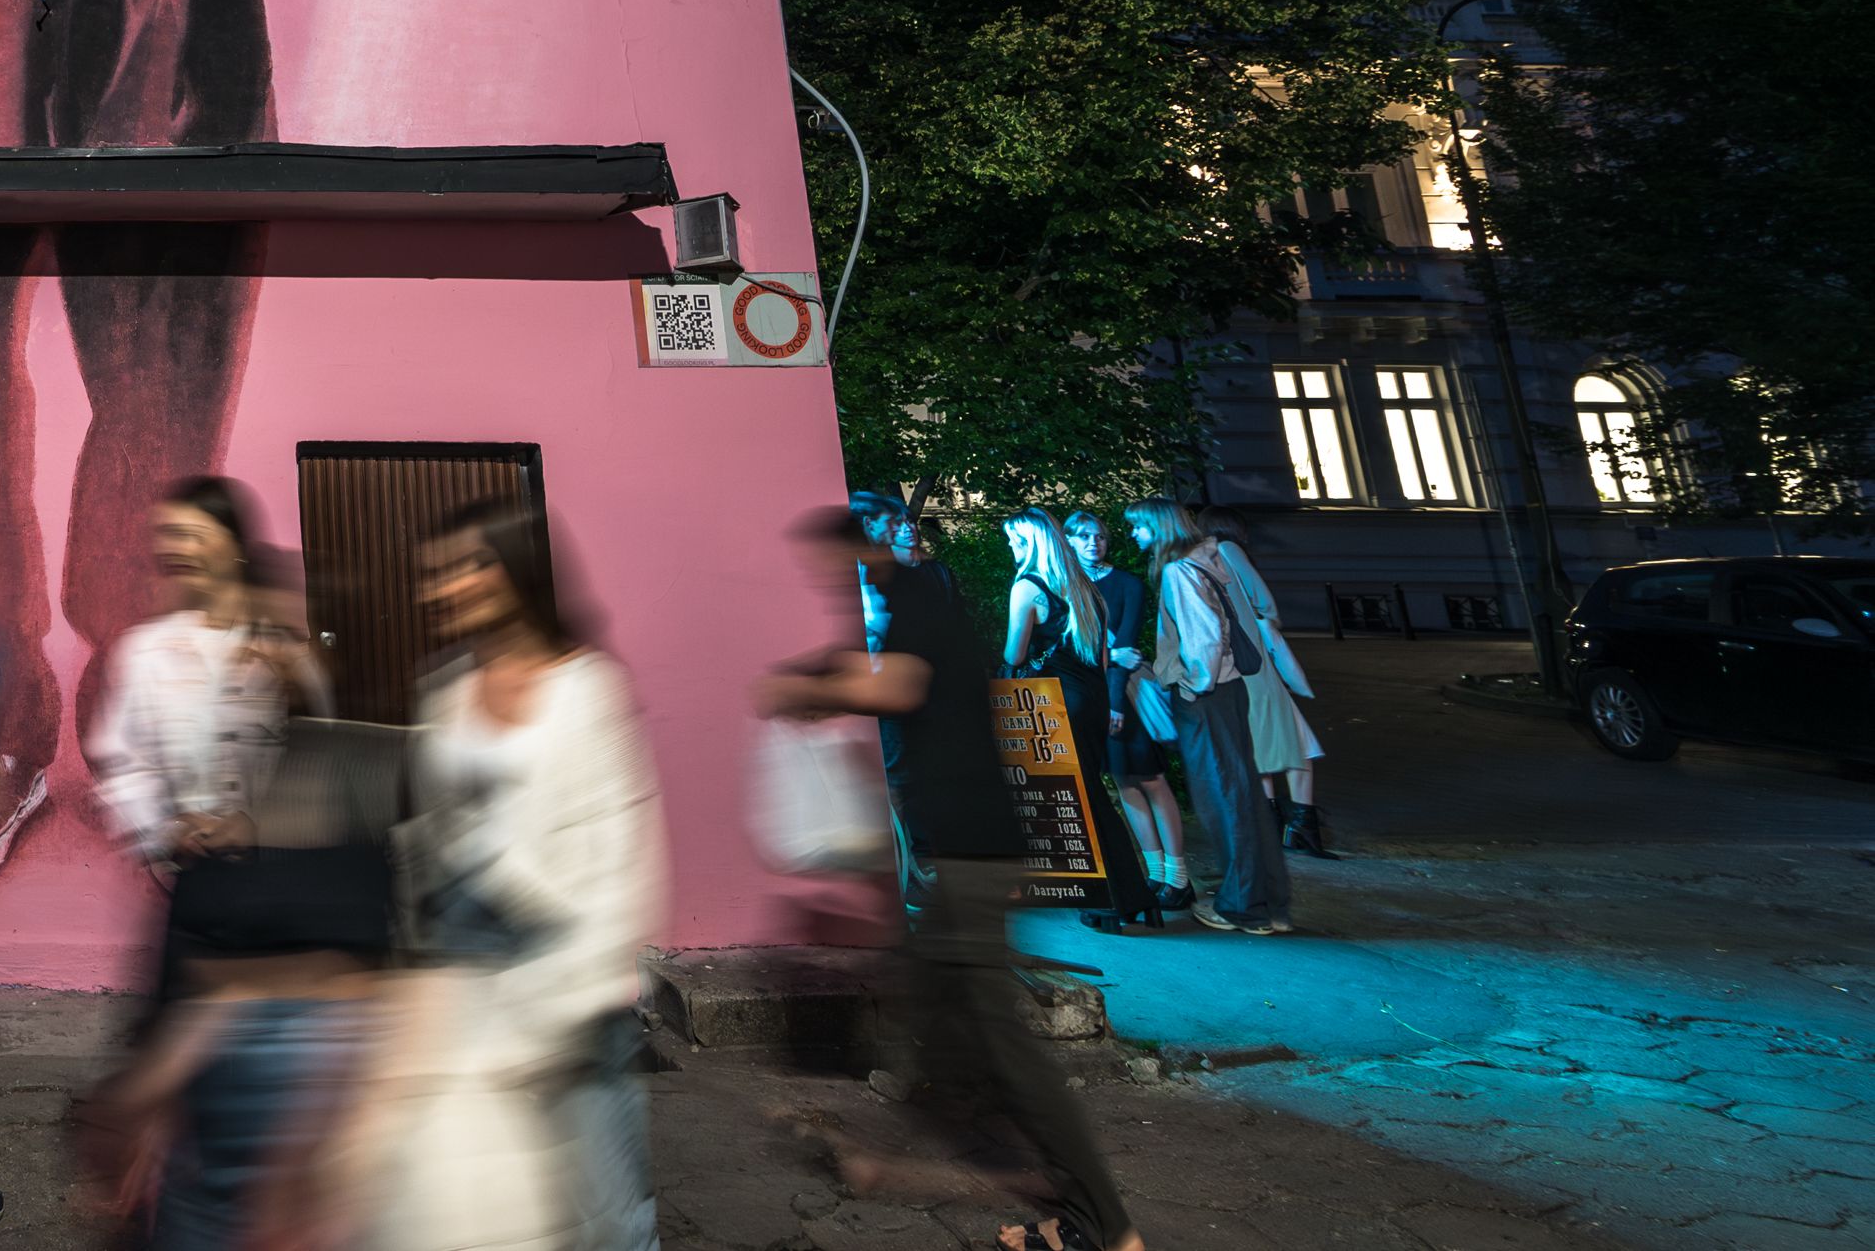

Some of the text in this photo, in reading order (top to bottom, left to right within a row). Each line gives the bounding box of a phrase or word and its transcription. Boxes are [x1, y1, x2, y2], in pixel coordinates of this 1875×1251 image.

[735, 286, 758, 316] GOOD
[736, 322, 810, 357] GOOD LOOKING
[1013, 687, 1036, 714] 10
[1029, 711, 1050, 737] 11
[1030, 737, 1054, 764] 16
